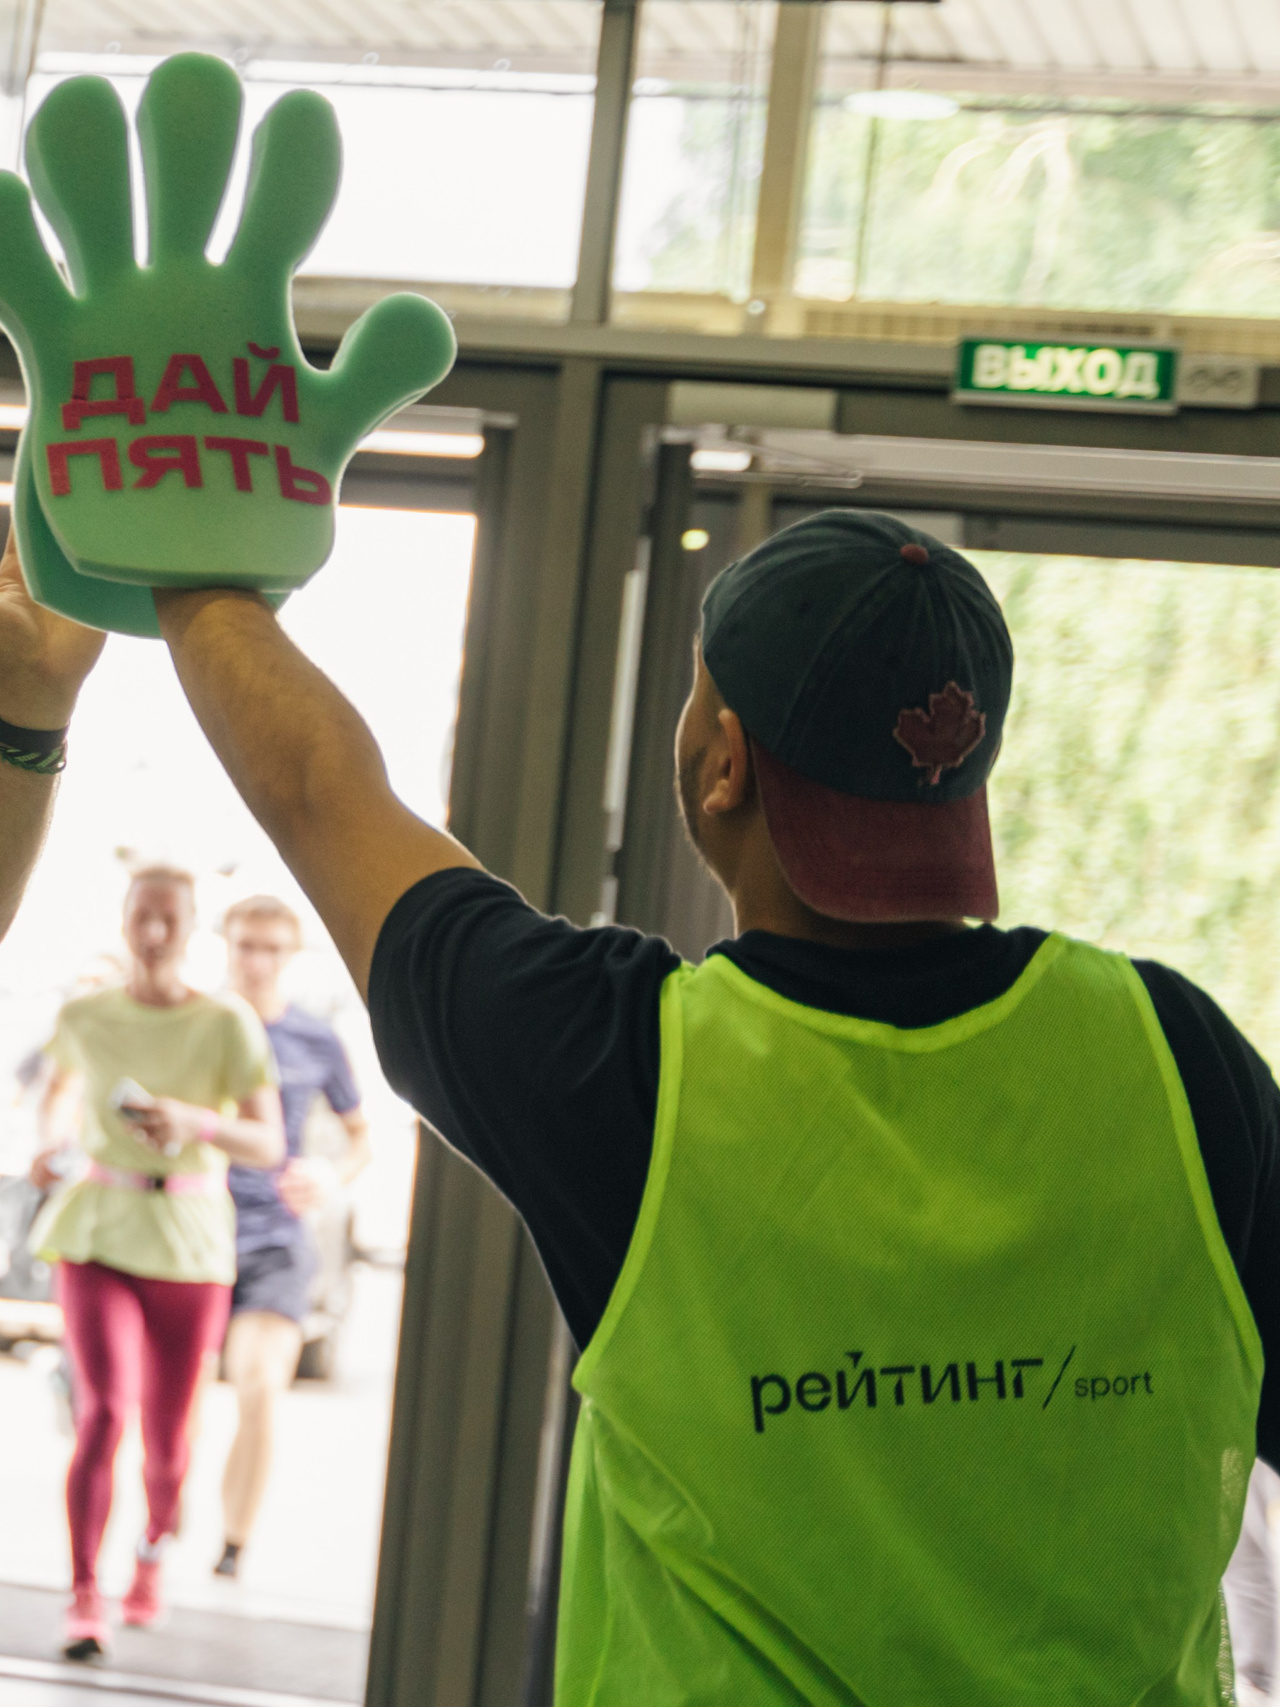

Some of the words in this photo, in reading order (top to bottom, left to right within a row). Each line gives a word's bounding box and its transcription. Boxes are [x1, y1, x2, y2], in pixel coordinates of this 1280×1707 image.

[61, 342, 300, 430] ДАЙ
[972, 344, 1159, 399] ВЫХОД
[46, 434, 333, 505] ПЯТЬ
